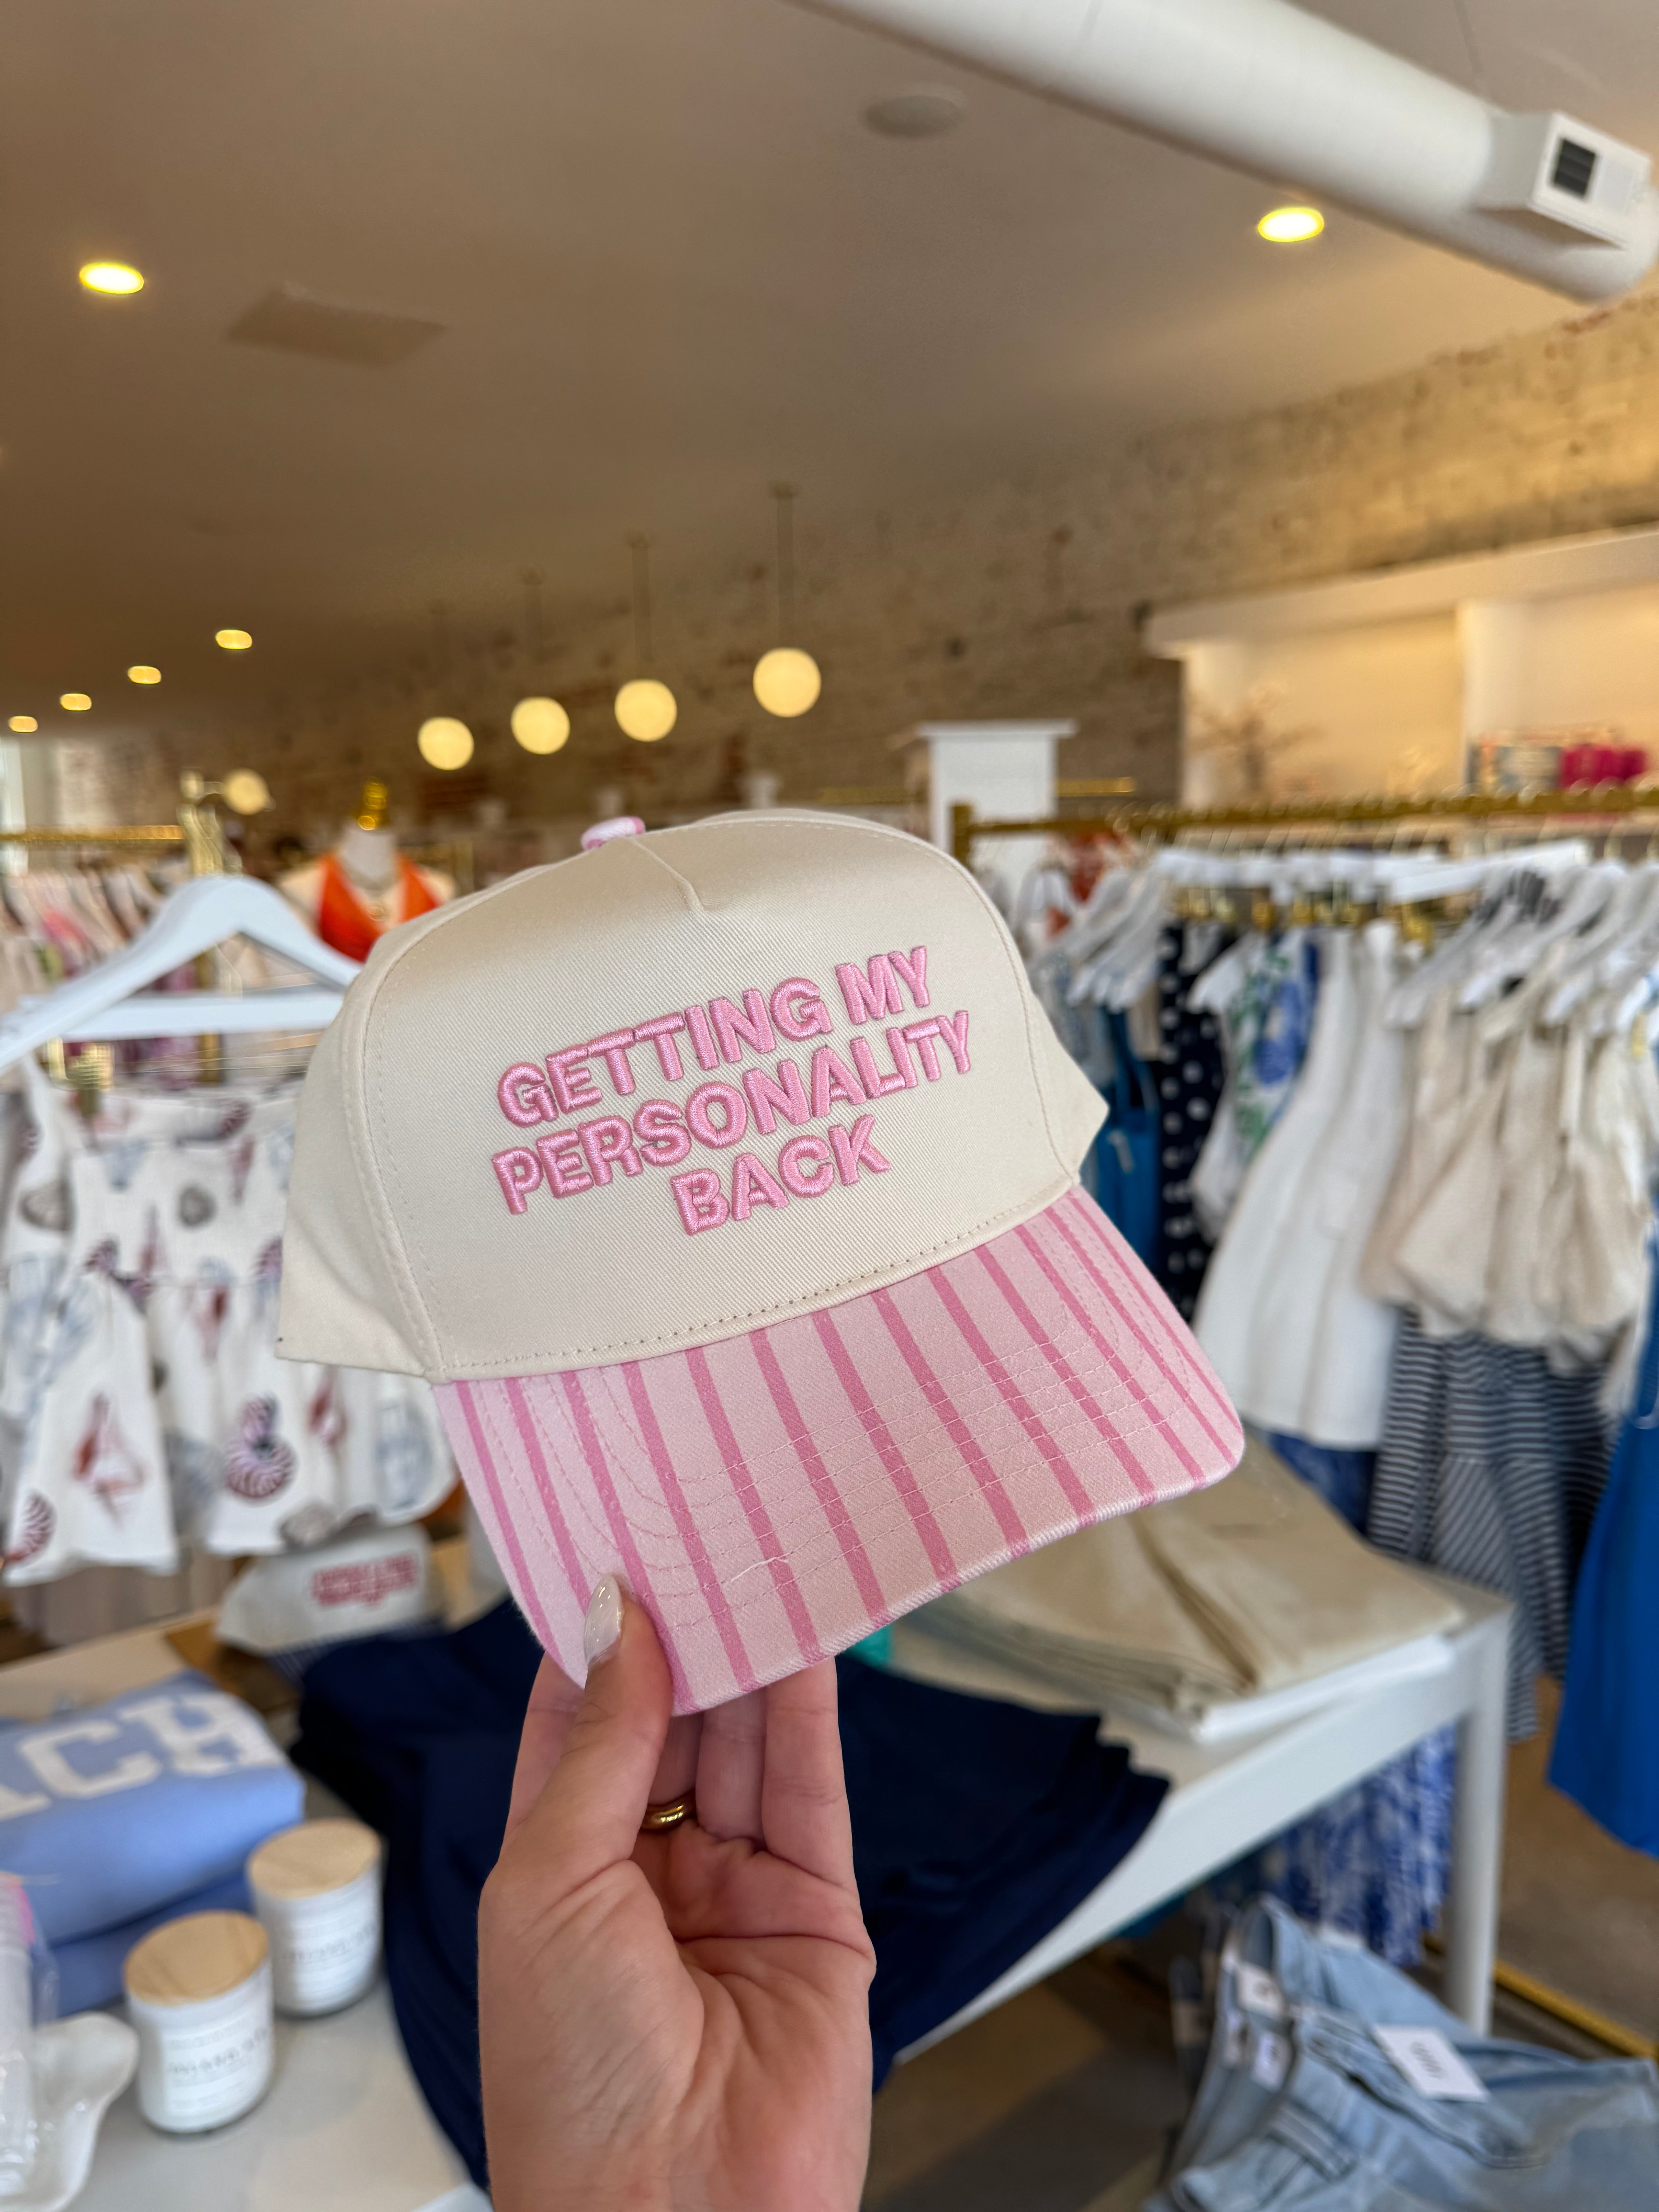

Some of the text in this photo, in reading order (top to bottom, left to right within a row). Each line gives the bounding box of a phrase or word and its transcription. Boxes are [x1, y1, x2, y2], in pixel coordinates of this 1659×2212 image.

[492, 1010, 971, 1214] PERSONALITY
[497, 946, 930, 1128] GETTING MY
[670, 1114, 890, 1236] BACK
[0, 1690, 287, 1820] CH
